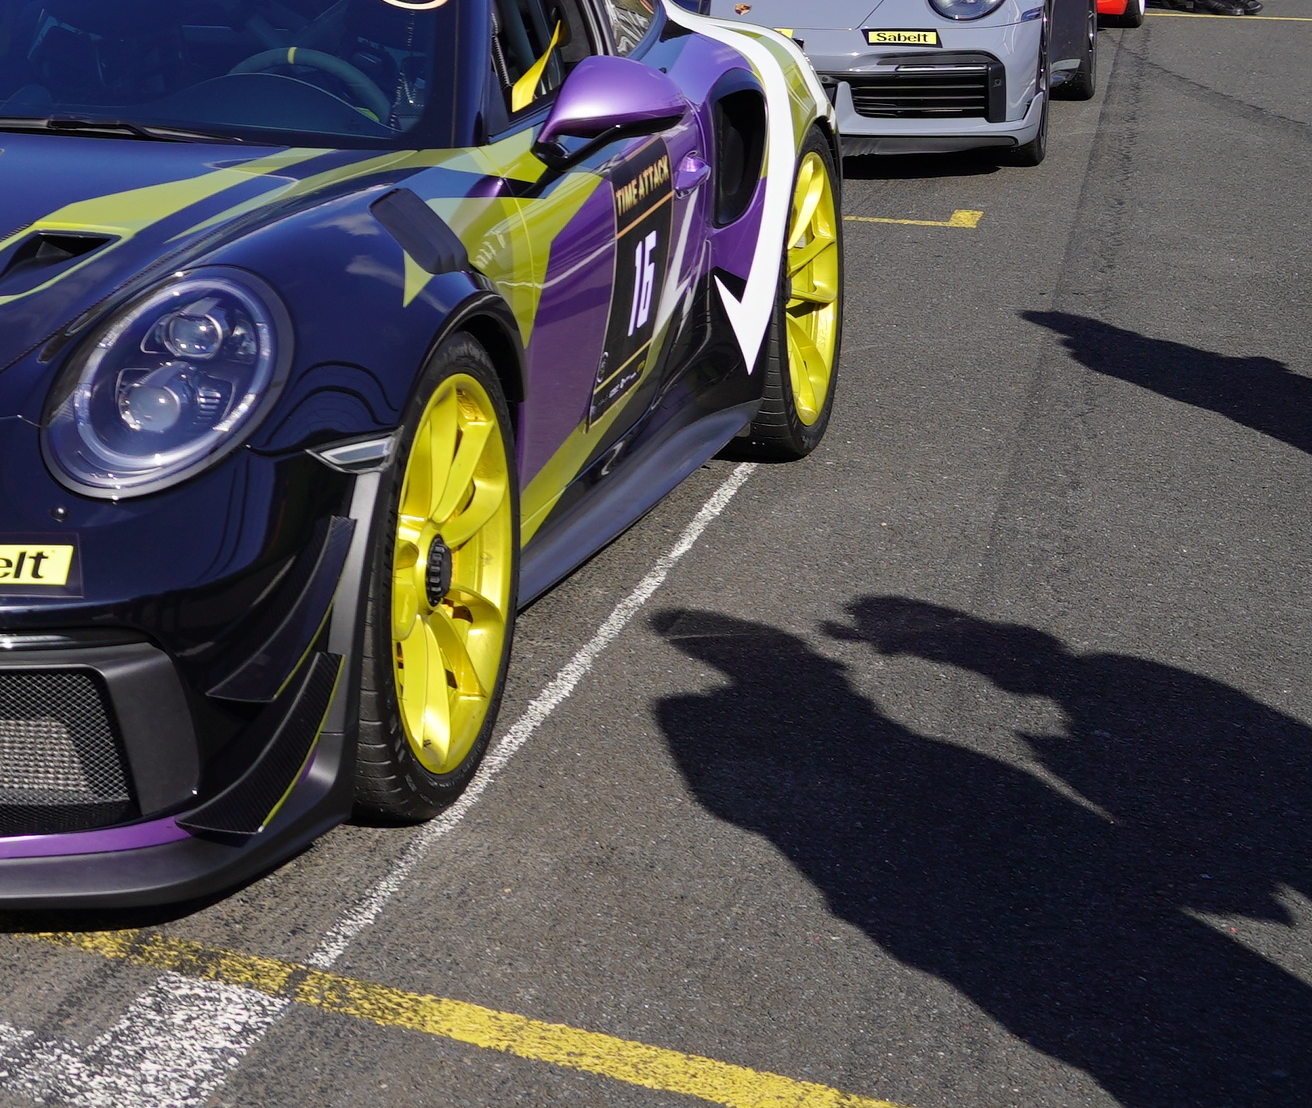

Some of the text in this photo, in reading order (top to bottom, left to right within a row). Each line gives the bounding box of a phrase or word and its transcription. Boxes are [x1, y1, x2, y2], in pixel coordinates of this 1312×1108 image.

[876, 32, 929, 43] Sabelt
[615, 155, 670, 217] TIME ATTACK
[627, 230, 658, 337] 16
